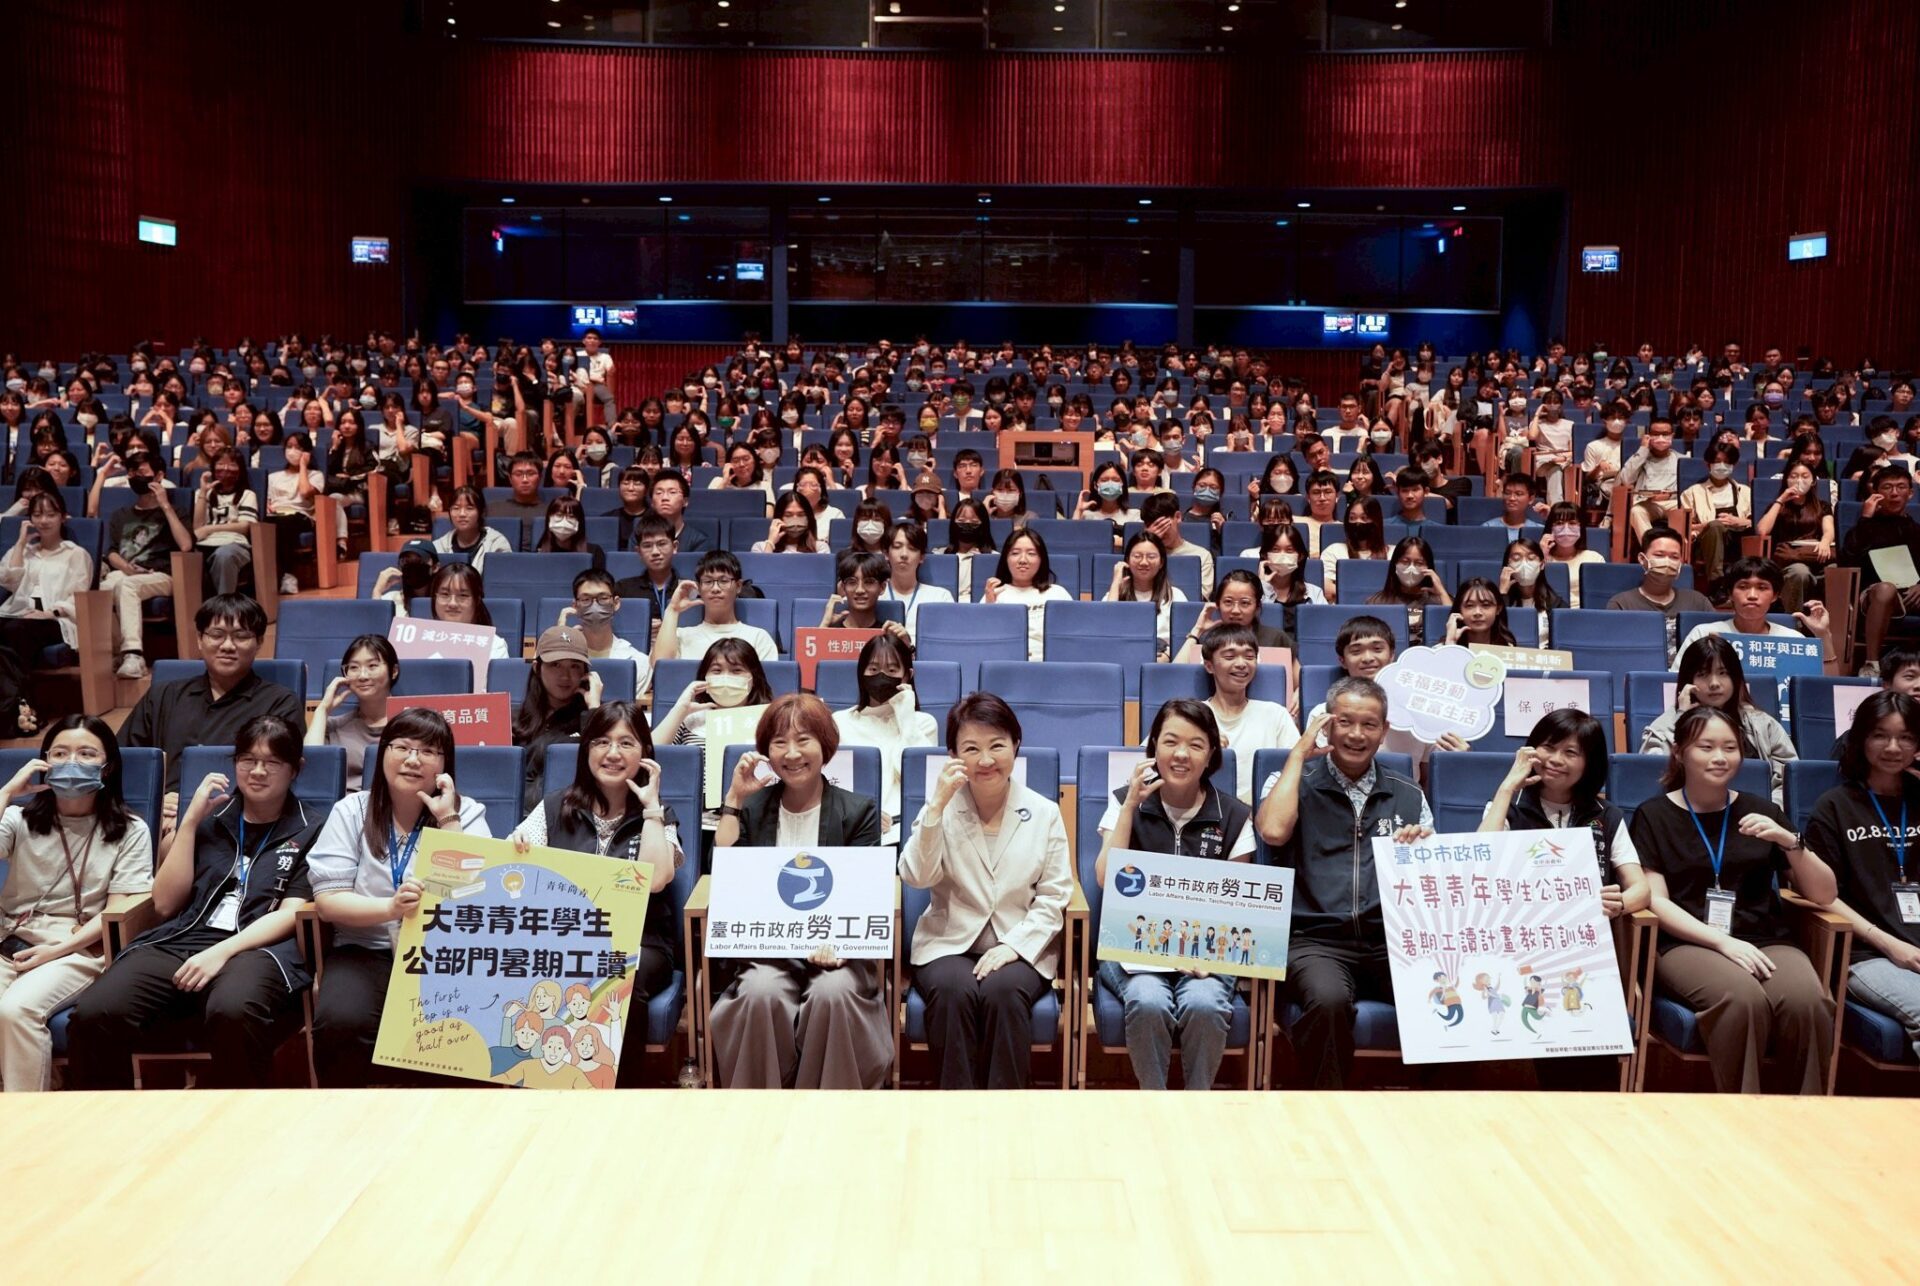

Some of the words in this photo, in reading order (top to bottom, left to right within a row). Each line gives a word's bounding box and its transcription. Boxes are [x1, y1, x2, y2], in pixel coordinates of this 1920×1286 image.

[396, 624, 417, 643] 10
[421, 629, 489, 647] 減少不平等
[805, 636, 817, 657] 5
[1748, 640, 1819, 657] 和平與正義
[1748, 655, 1777, 669] 制度
[441, 707, 489, 725] 育品質
[713, 715, 733, 737] 11
[1394, 842, 1491, 865] 臺中市政府
[1149, 874, 1283, 903] 臺中市政府勞工局
[1393, 873, 1592, 908] 大專青年學生公部門
[1165, 892, 1184, 900] Affairs
[1208, 897, 1234, 907] Taichung
[1247, 902, 1282, 911] Government
[422, 903, 613, 938] 大專青年學生
[711, 914, 890, 940] 臺中市政府勞工局
[710, 943, 731, 951] Labor
[733, 943, 757, 951] Affairs
[789, 943, 820, 952] Taichun
[842, 943, 889, 952] Government
[1401, 923, 1598, 957] 暑期工讀計畫教育訓練
[402, 945, 627, 980] 公部門暑期工讀
[409, 997, 430, 1012] The
[434, 987, 461, 1005] first
[412, 1011, 438, 1027] step
[456, 1004, 470, 1014] as
[416, 1020, 445, 1044] good
[449, 1021, 463, 1031] as
[418, 1036, 442, 1053] half
[447, 1033, 471, 1045] over
